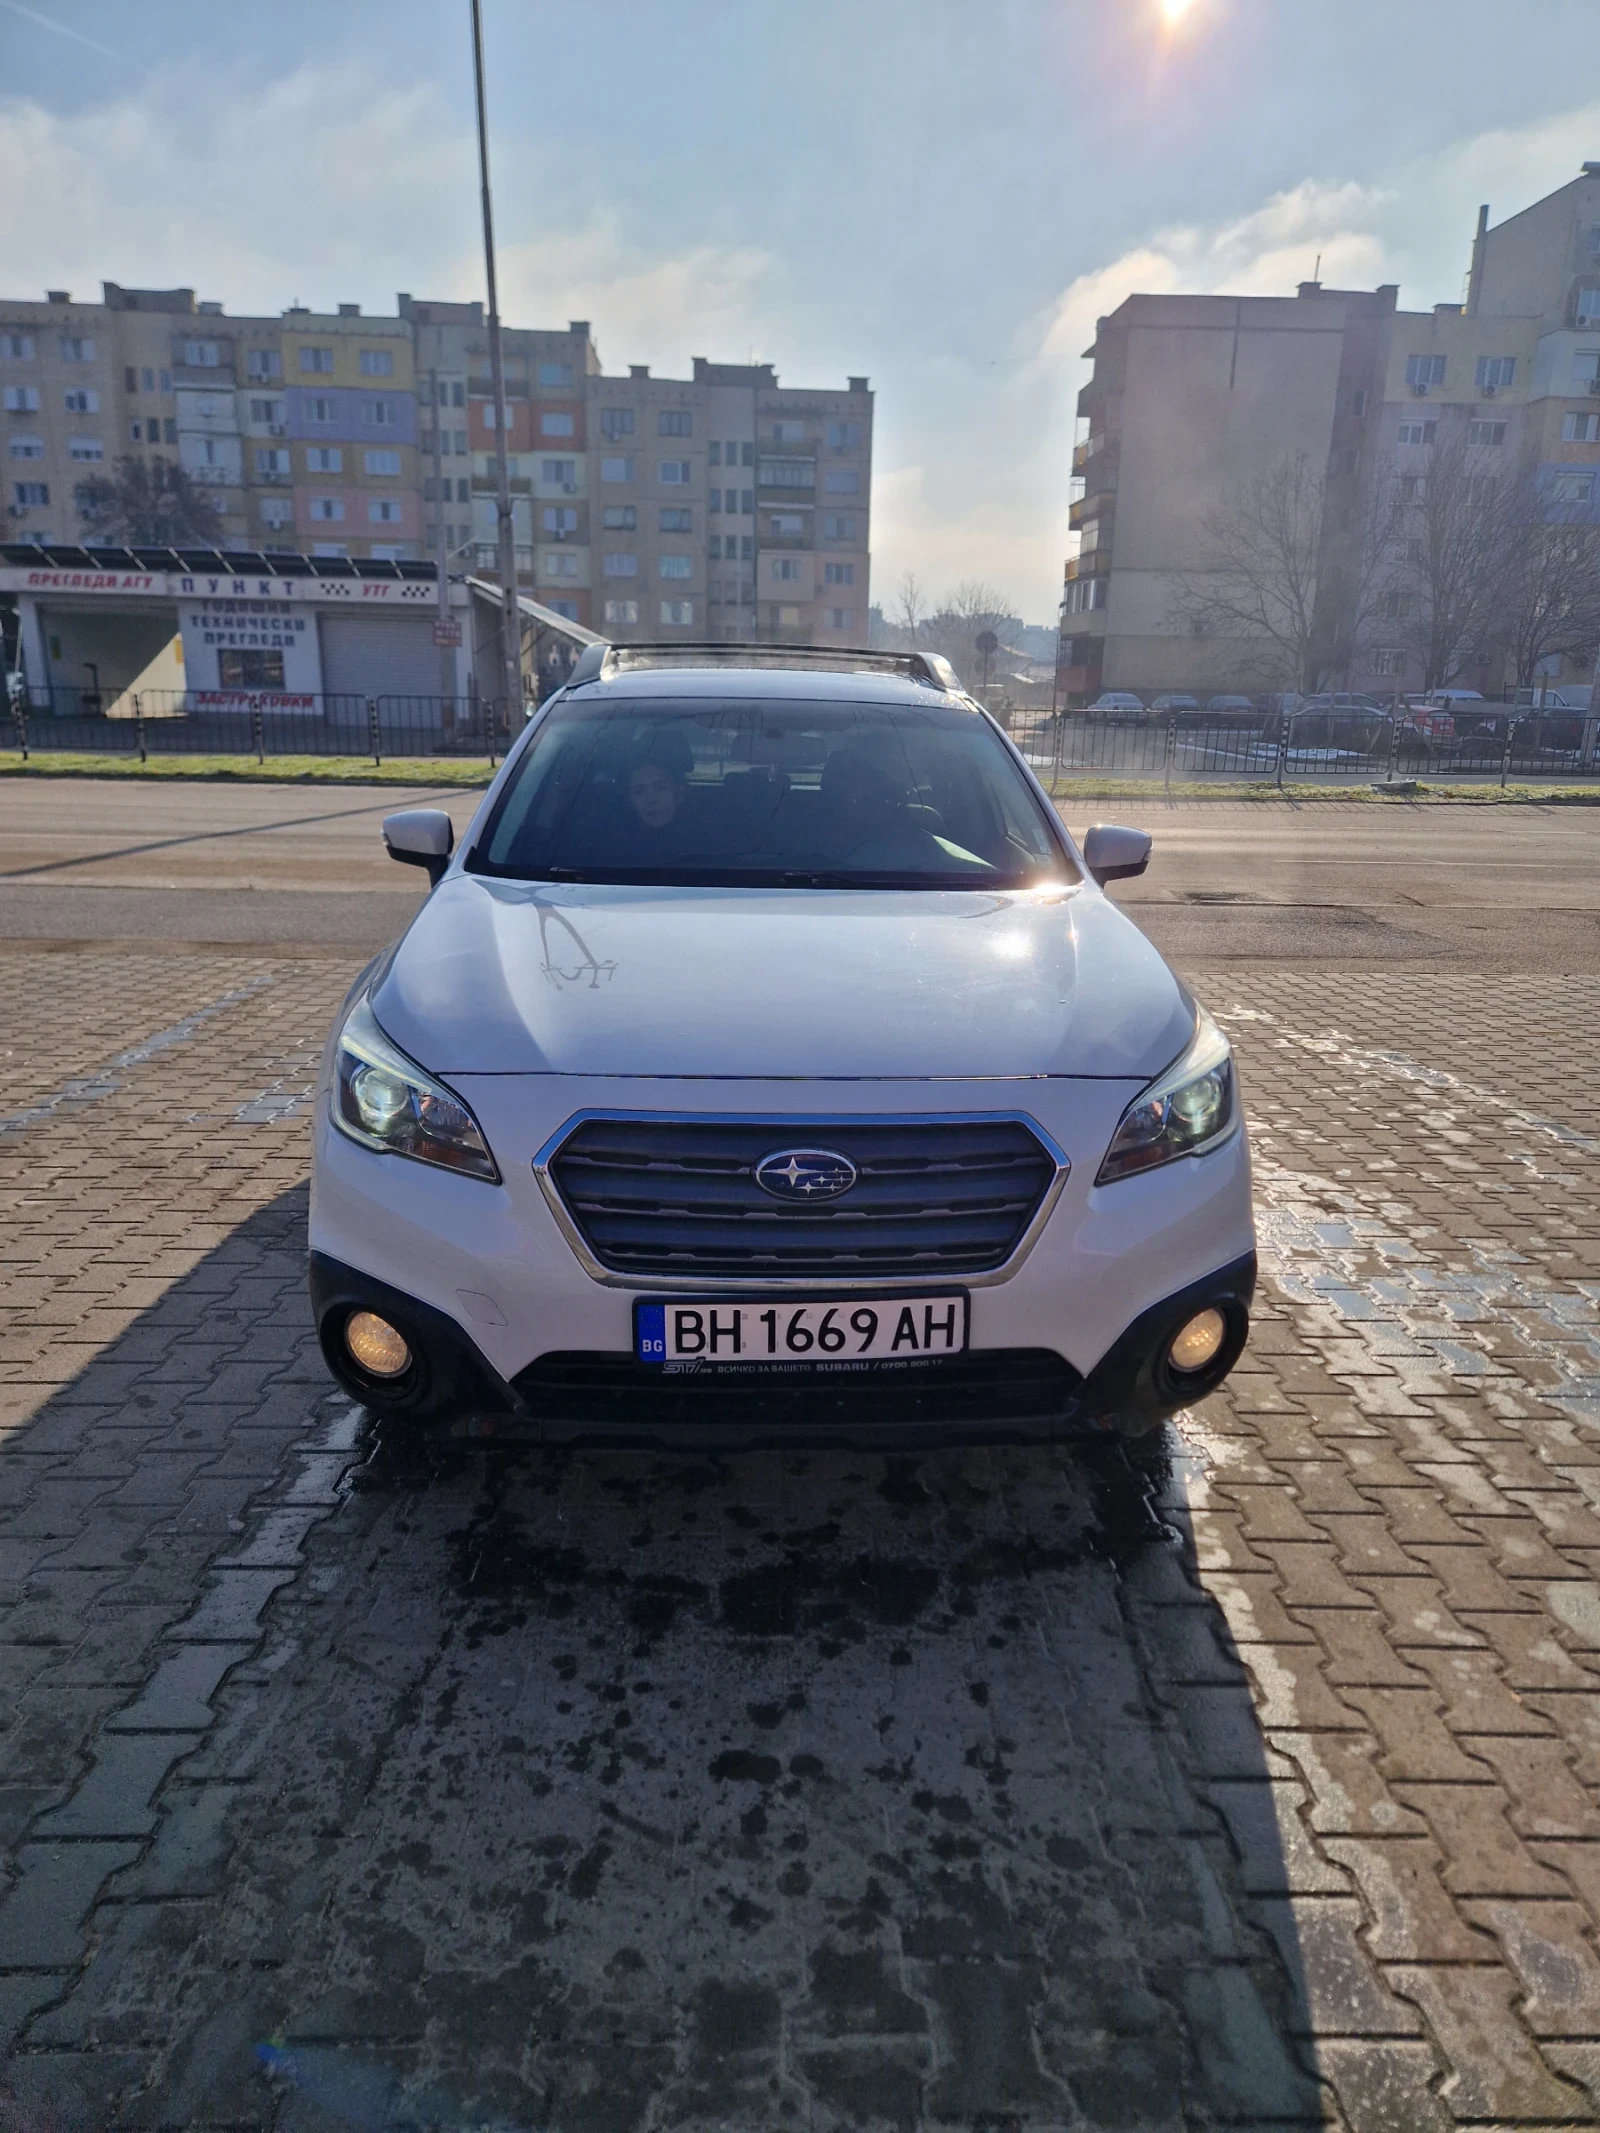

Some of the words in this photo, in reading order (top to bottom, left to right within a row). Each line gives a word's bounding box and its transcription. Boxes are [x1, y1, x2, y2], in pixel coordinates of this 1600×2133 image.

[28, 572, 118, 588] ПРЕГЛЕДИ
[190, 615, 305, 631] ТЕХНИЧЕСКИ
[204, 632, 295, 647] ПРЕГЛЕДИ
[760, 1308, 878, 1353] 1669
[642, 1340, 663, 1352] BG
[717, 1365, 755, 1373] ВСИЧКО
[757, 1365, 769, 1373] ЗА
[771, 1364, 811, 1372] ВАШЕТО
[816, 1362, 869, 1372] SUBARU
[881, 1361, 907, 1369] 0700
